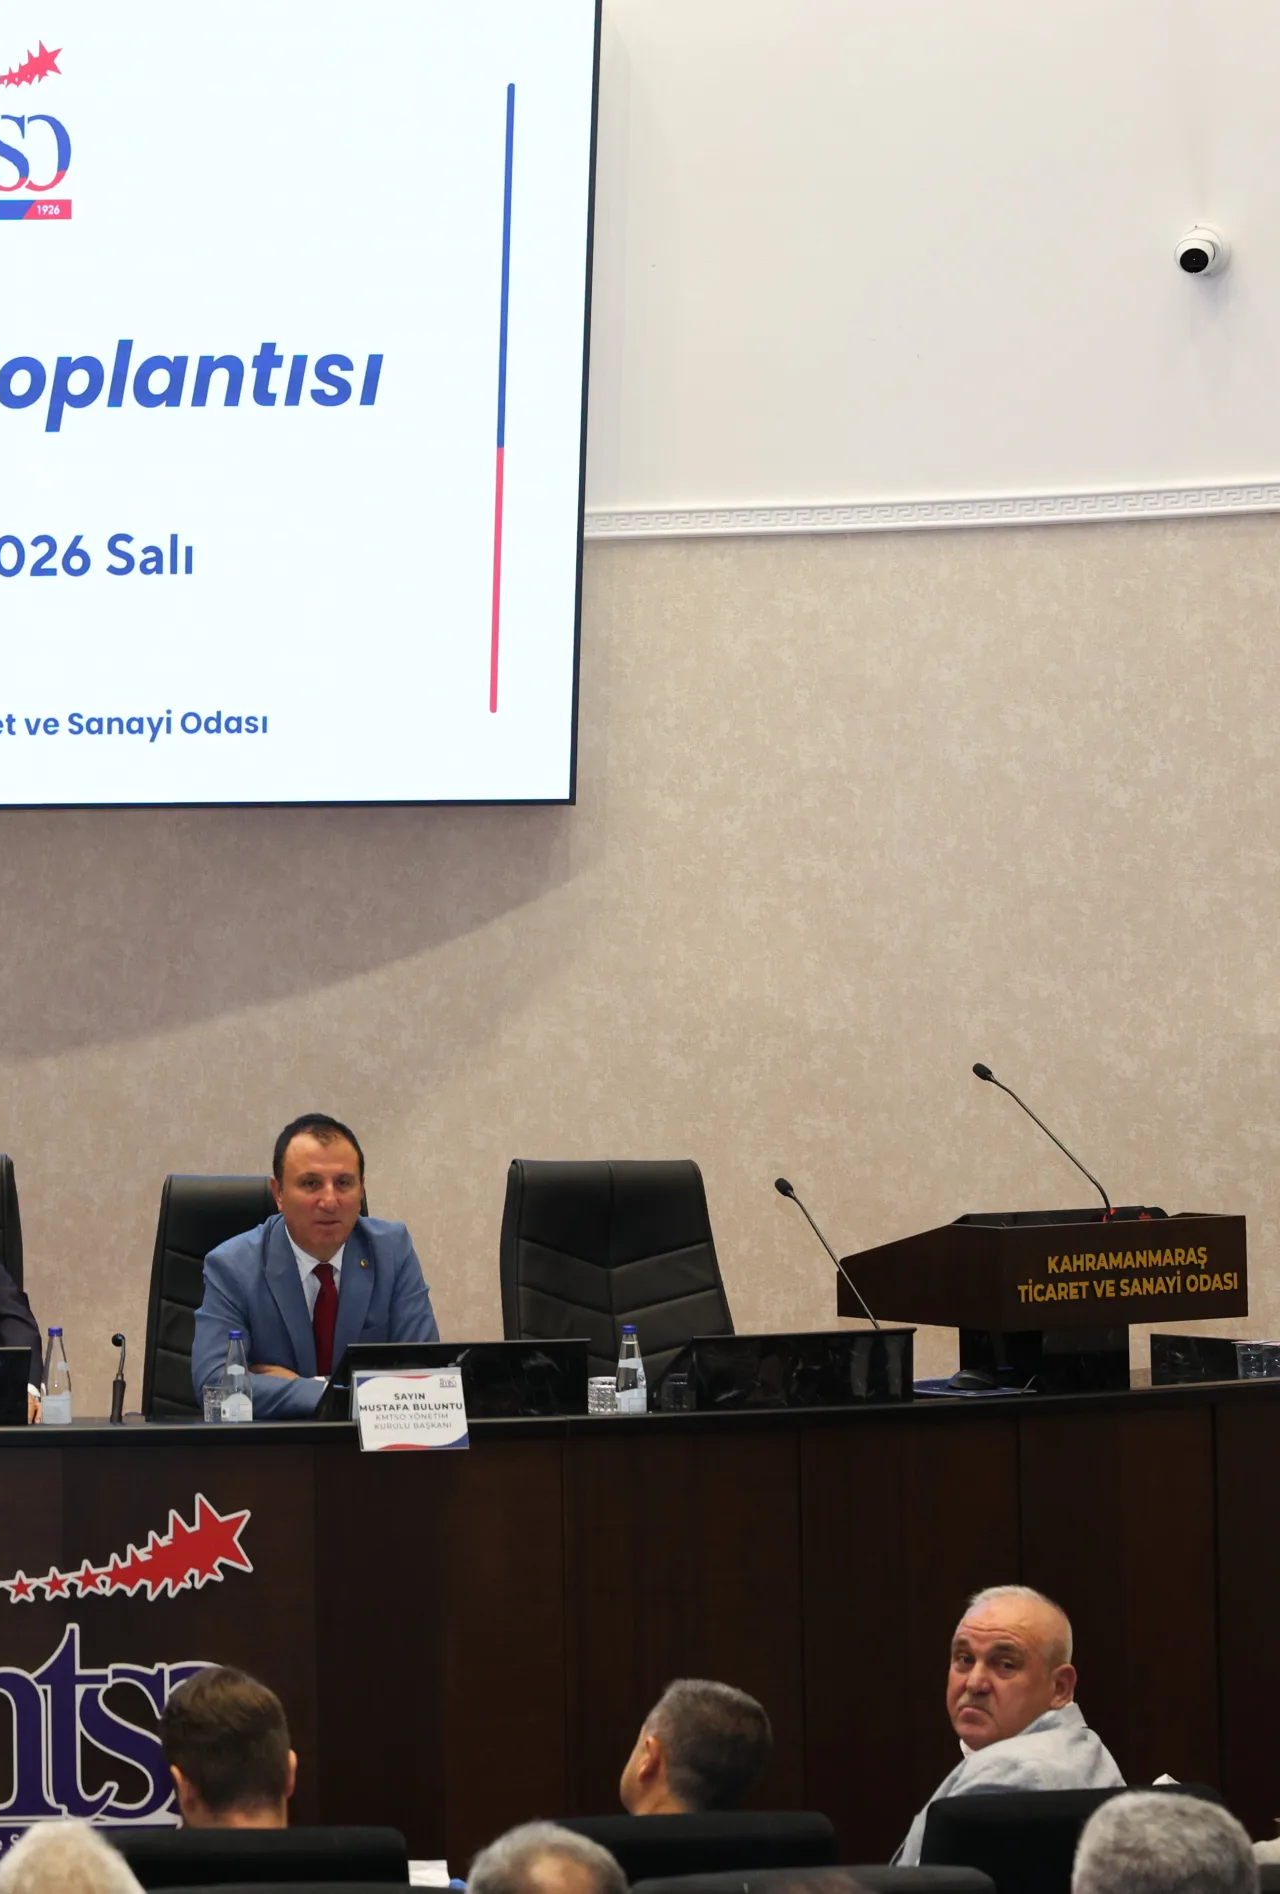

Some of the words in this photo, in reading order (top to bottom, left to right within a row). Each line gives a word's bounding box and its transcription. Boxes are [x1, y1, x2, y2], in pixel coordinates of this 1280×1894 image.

[36, 204, 61, 216] 1926
[106, 533, 193, 576] Salı
[25, 717, 60, 736] ve
[67, 709, 173, 743] Sanayi
[180, 711, 268, 735] Odası
[1047, 1246, 1208, 1274] KAHRAMANMARAŞ
[1018, 1279, 1090, 1303] TİCARET
[1092, 1280, 1116, 1298] VE
[1120, 1270, 1182, 1297] SANAYİ
[1186, 1272, 1238, 1293] ODASI
[359, 1403, 409, 1412] MUSTAFA
[413, 1402, 463, 1411] BULUNTU
[394, 1393, 426, 1401] SAYIN
